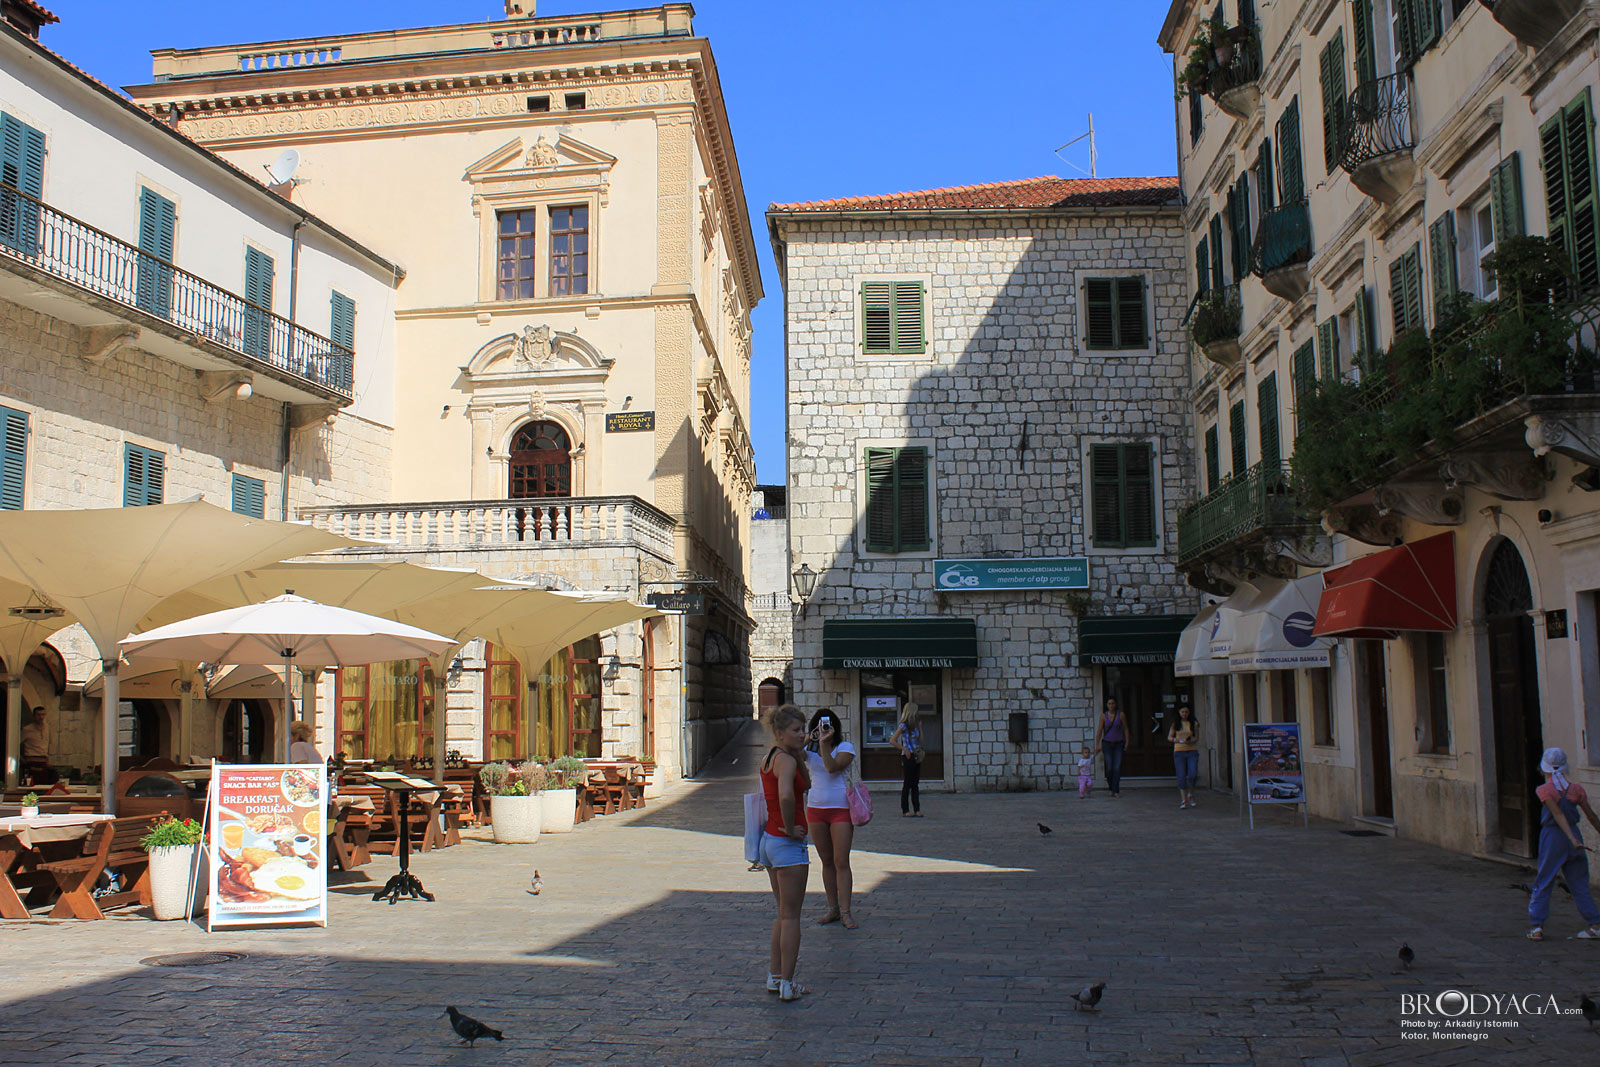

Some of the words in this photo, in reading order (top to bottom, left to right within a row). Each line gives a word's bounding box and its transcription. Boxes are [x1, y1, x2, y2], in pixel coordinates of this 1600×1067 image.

[609, 416, 652, 424] RESTAURANT
[1035, 576, 1049, 584] otp
[1049, 575, 1071, 584] group
[661, 599, 691, 610] Cattaro
[843, 659, 882, 668] CRNOGORSKA
[885, 658, 930, 668] KOMERCIJALNA
[932, 658, 953, 667] BANKA
[1091, 655, 1131, 664] CRNOGORSKA
[1255, 655, 1298, 663] KOMERCIJALNA
[223, 795, 280, 804] BREAKFAST
[245, 803, 294, 814] DORUČAK
